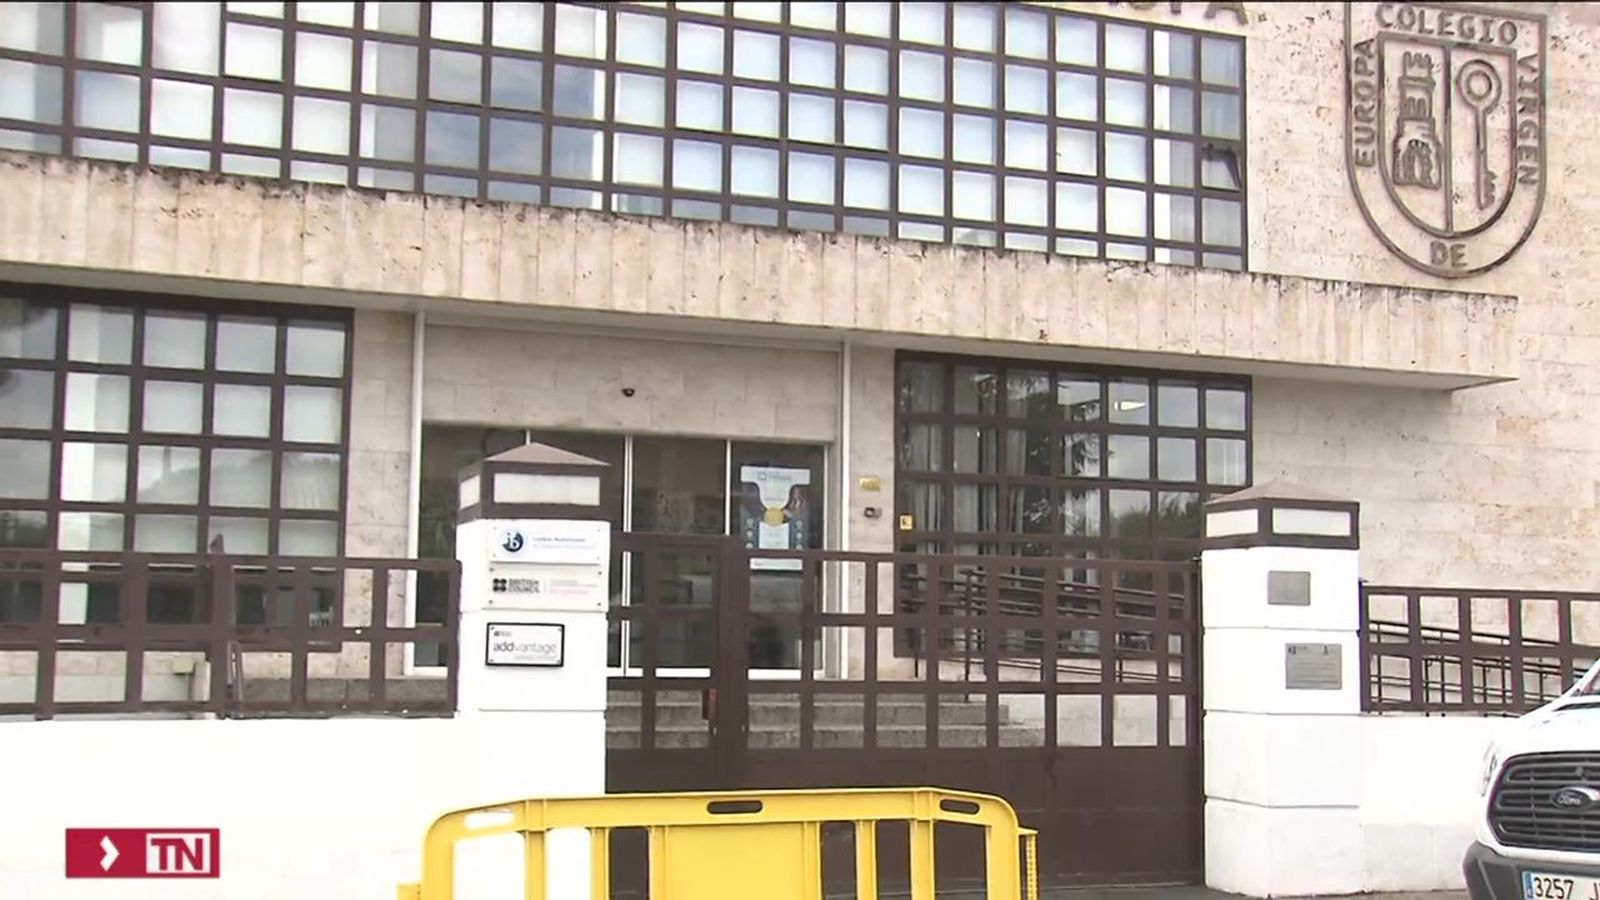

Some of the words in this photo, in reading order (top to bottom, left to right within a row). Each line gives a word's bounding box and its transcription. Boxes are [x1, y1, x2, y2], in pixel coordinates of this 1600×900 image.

[1375, 4, 1518, 45] COLEGIO
[1353, 38, 1376, 168] EUROPA
[1517, 53, 1540, 186] VIRGEN
[1429, 241, 1468, 268] DE
[1533, 876, 1575, 900] 3257
